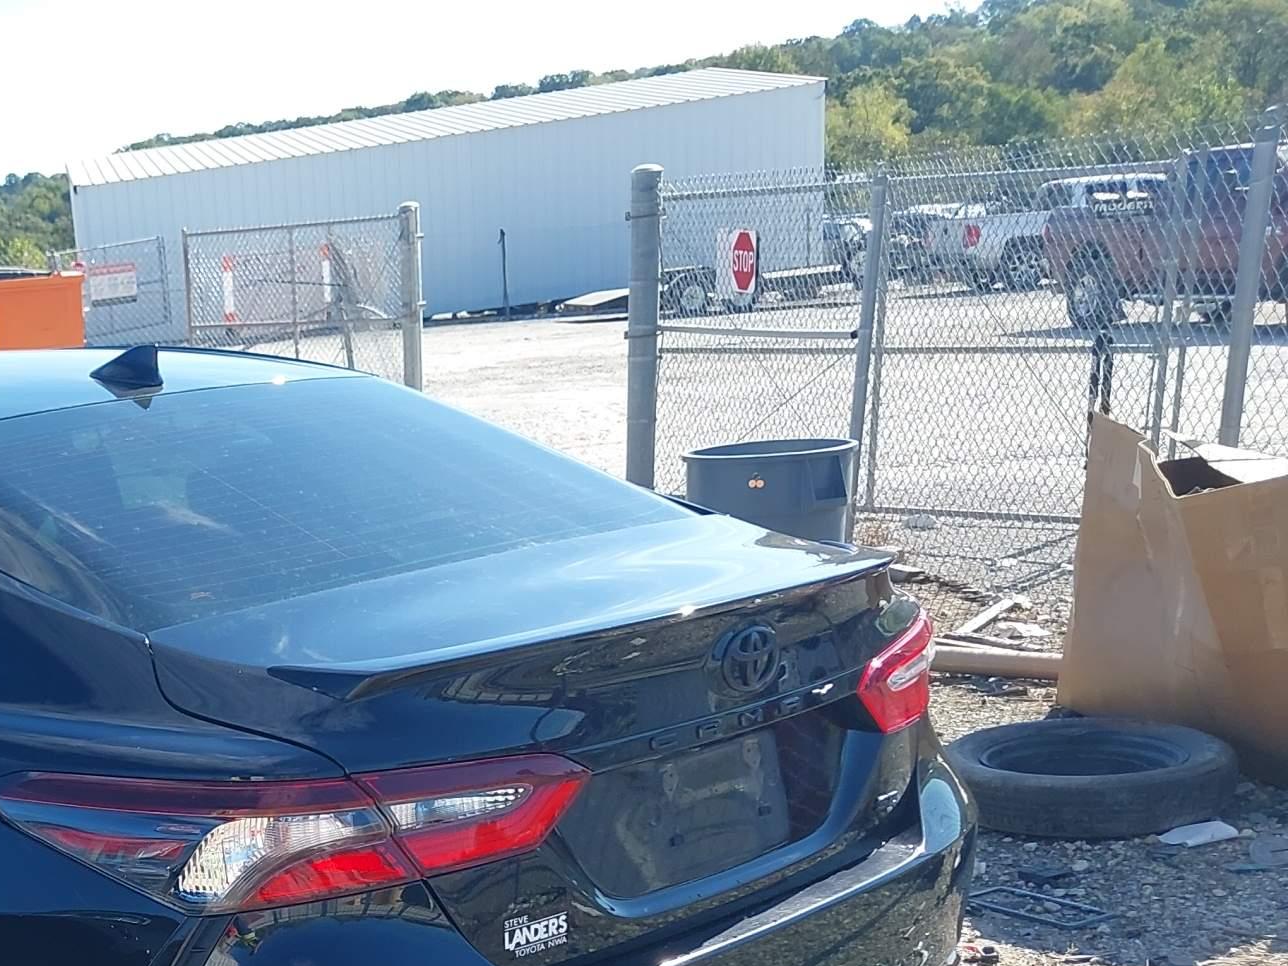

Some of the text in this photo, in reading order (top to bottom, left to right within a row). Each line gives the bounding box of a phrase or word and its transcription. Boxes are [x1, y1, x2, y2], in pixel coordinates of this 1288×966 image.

[733, 250, 754, 272] STOP
[504, 915, 529, 928] STEVE
[504, 915, 568, 951] LANDERS
[515, 936, 568, 958] TOYOTA NWA
